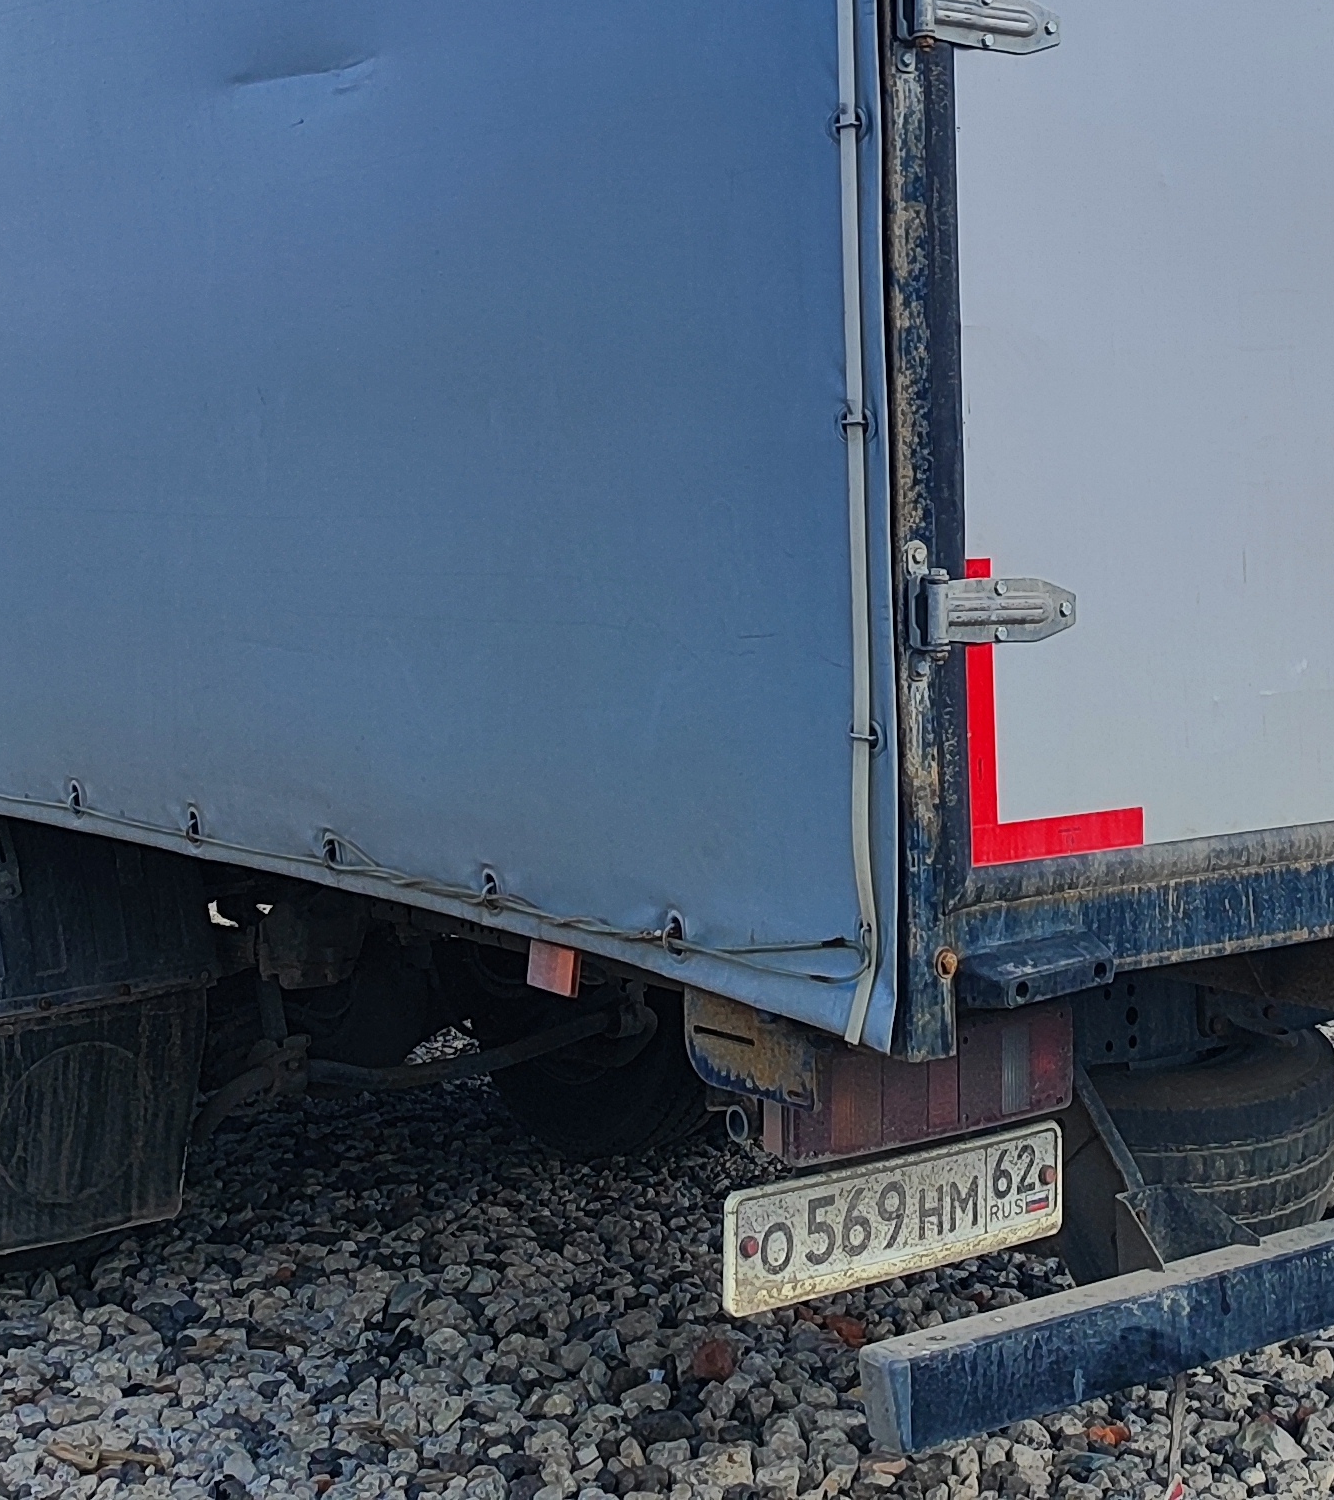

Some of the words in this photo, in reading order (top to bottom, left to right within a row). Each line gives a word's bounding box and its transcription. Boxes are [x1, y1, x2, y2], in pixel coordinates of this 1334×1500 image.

[761, 1175, 978, 1274] О569НМ
[992, 1144, 1036, 1200] 62
[989, 1202, 1024, 1222] RUS
